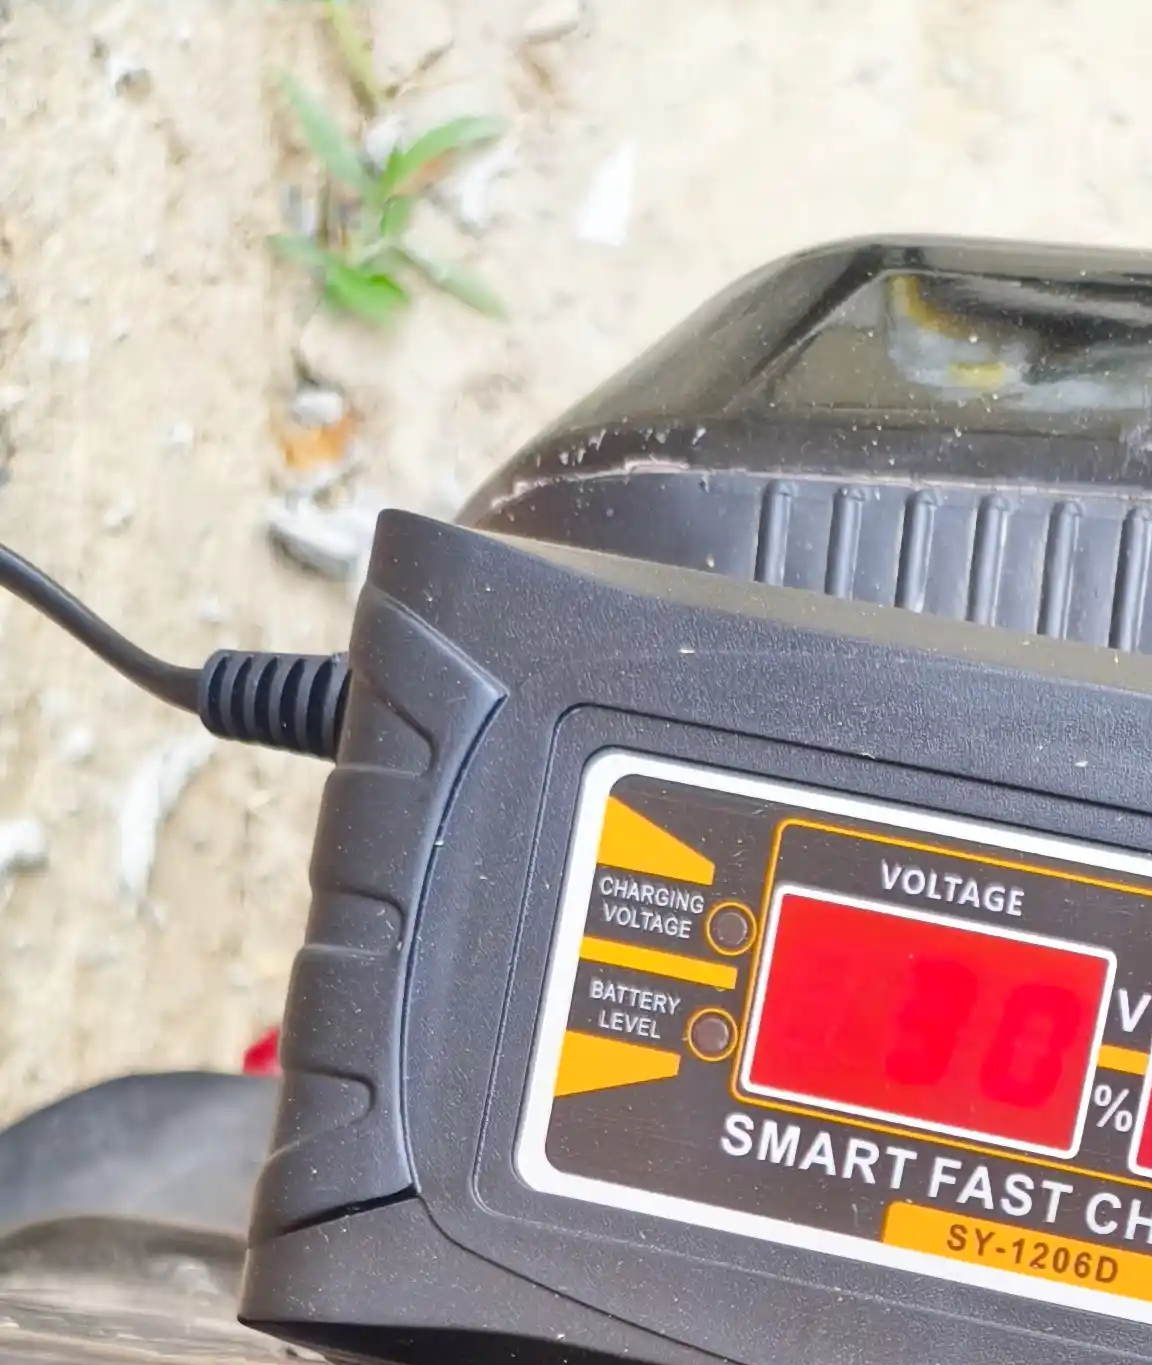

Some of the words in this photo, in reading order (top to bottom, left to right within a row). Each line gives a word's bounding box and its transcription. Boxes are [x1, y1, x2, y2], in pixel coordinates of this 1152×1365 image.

[599, 876, 705, 915] CHARGING
[880, 858, 1025, 917] VOLTAGE
[602, 903, 693, 940] VOLTAGE
[589, 980, 681, 1016] BATTERY
[1117, 989, 1152, 1033] V
[598, 1011, 662, 1040] LEVEL
[1093, 1084, 1133, 1133] %
[719, 1112, 918, 1190] SMART
[927, 1156, 1074, 1225] FAST
[945, 1222, 1120, 1285] SY-1206D
